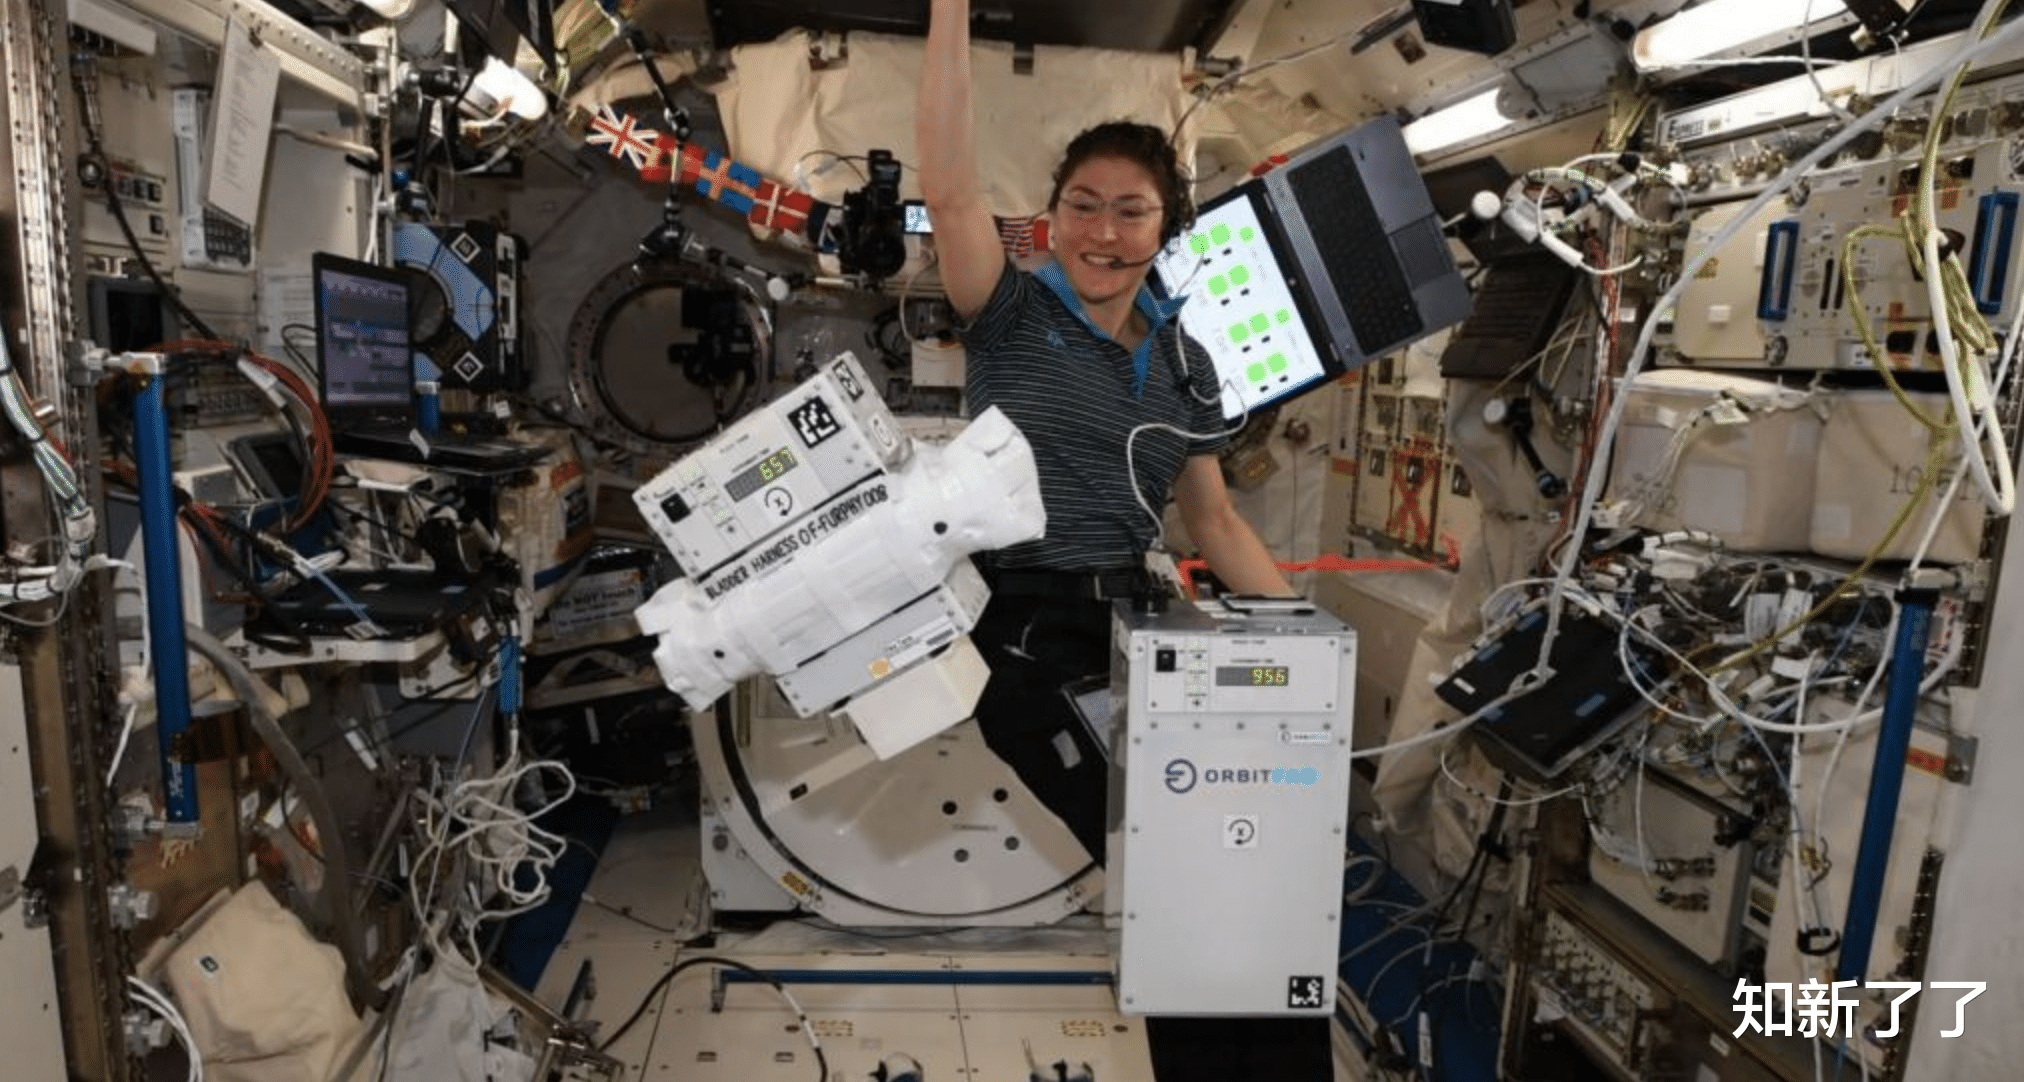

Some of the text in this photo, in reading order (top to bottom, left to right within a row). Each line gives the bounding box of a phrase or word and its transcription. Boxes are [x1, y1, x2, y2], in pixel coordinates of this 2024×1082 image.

[759, 447, 794, 481] 657
[705, 565, 749, 600] BLADDER
[751, 534, 799, 572] HARNESS
[1253, 668, 1286, 684] 956
